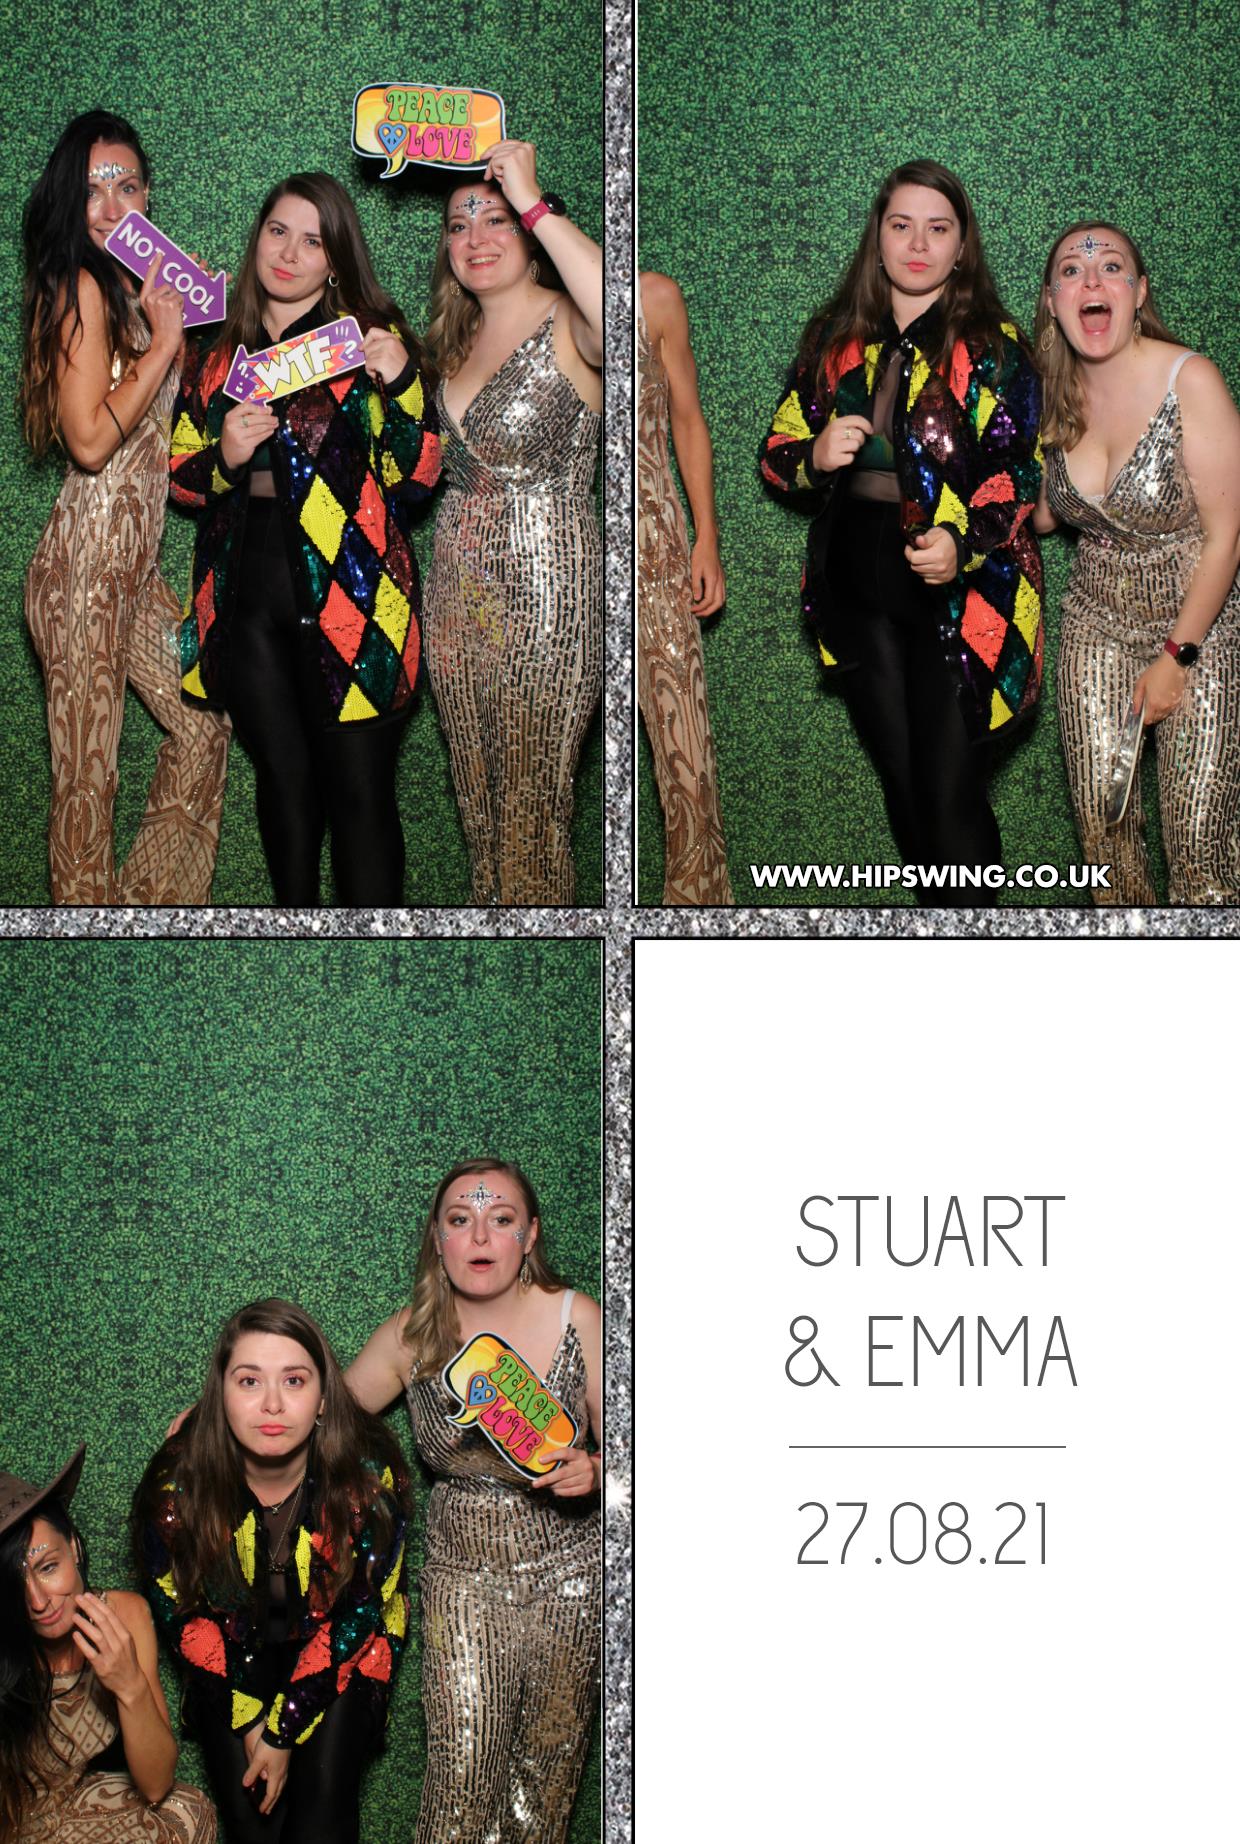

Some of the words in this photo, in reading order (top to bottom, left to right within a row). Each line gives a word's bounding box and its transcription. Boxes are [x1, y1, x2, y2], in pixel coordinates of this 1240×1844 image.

[386, 90, 470, 126] PEACE
[405, 124, 474, 160] LOVE
[162, 262, 215, 315] COOL
[488, 1353, 560, 1432] PEACE
[480, 1396, 543, 1461] LOVE
